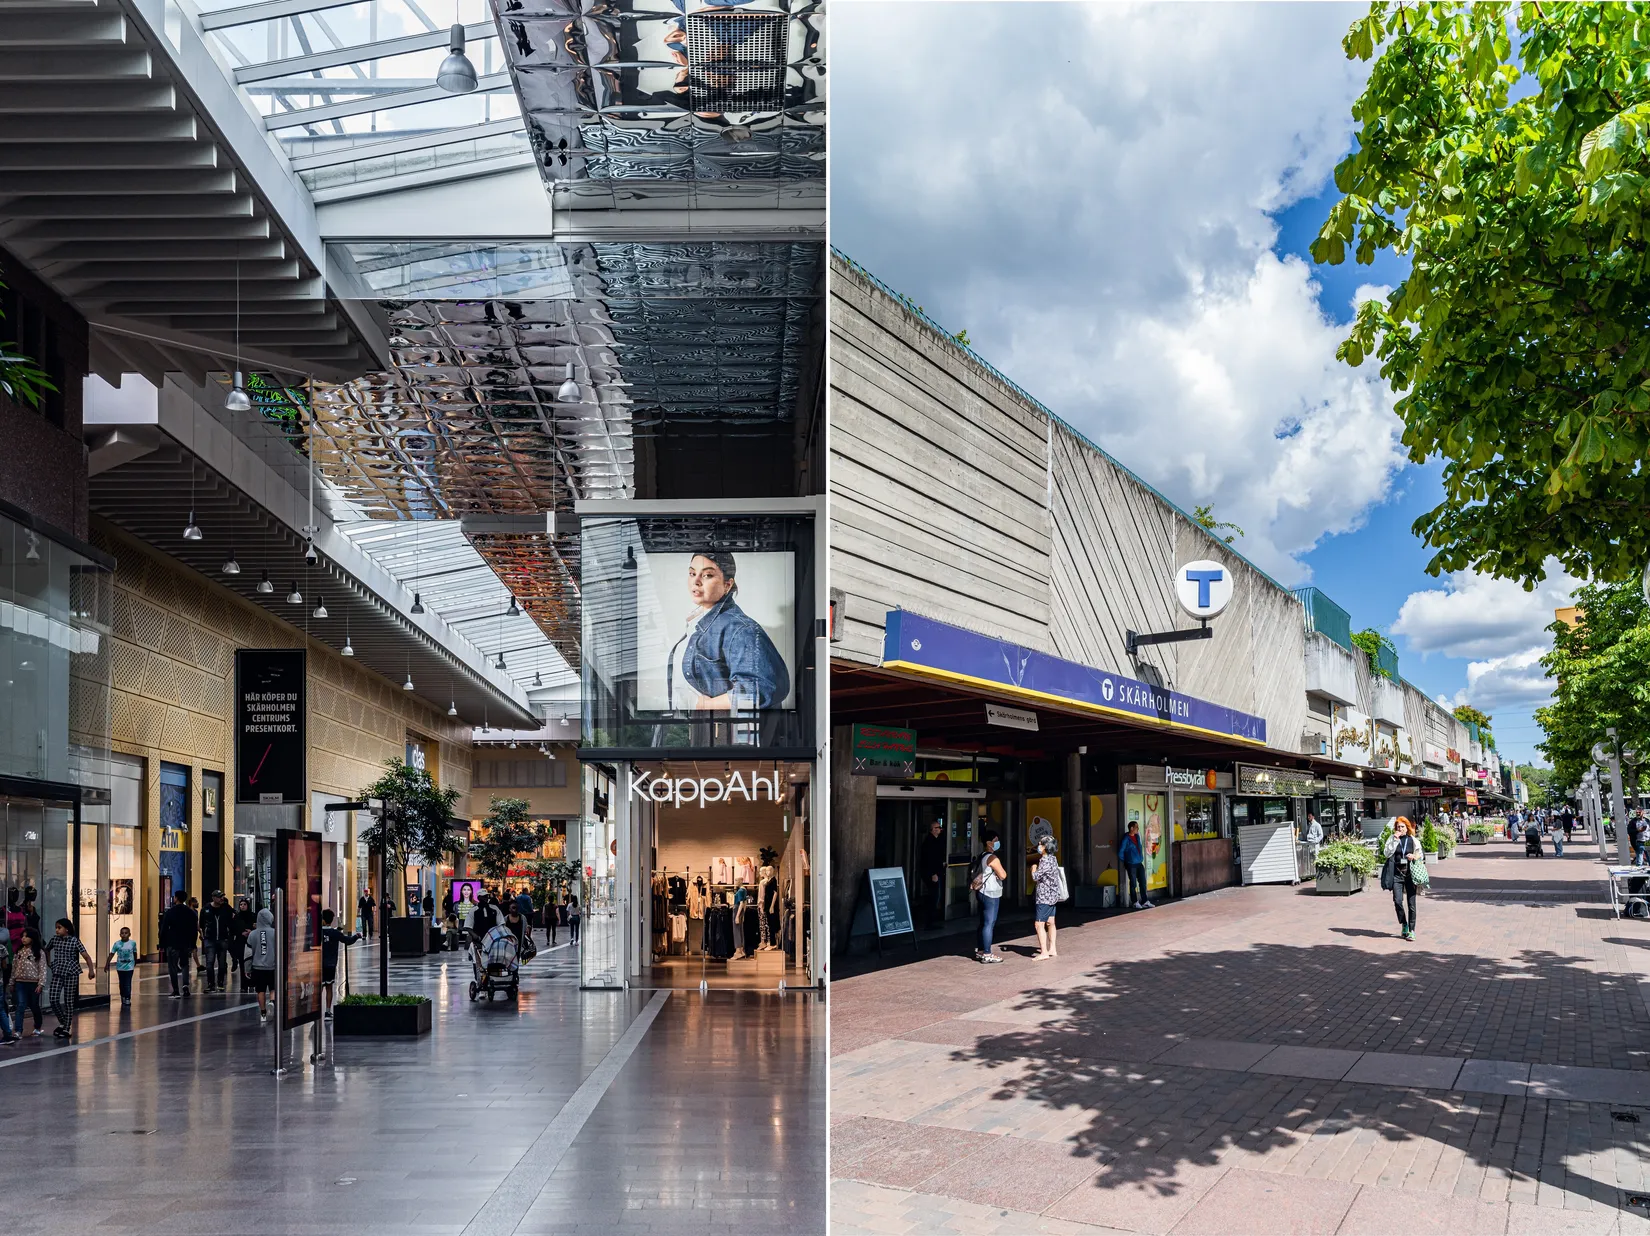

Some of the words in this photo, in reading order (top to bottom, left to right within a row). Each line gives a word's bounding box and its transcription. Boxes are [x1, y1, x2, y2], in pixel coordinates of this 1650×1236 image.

[1186, 570, 1223, 607] T
[245, 692, 260, 701] HÄR
[261, 692, 285, 701] KÖPER
[287, 693, 297, 701] DU
[1119, 684, 1189, 718] SKÄRHOLMEN
[246, 702, 296, 712] SKÄRHOLMEN
[252, 714, 290, 722] CENTRUMS
[245, 724, 298, 733] PRESENTKORT.
[1165, 765, 1206, 789] Pressbyrån
[627, 770, 780, 809] KappAhl
[160, 829, 179, 849] ATM
